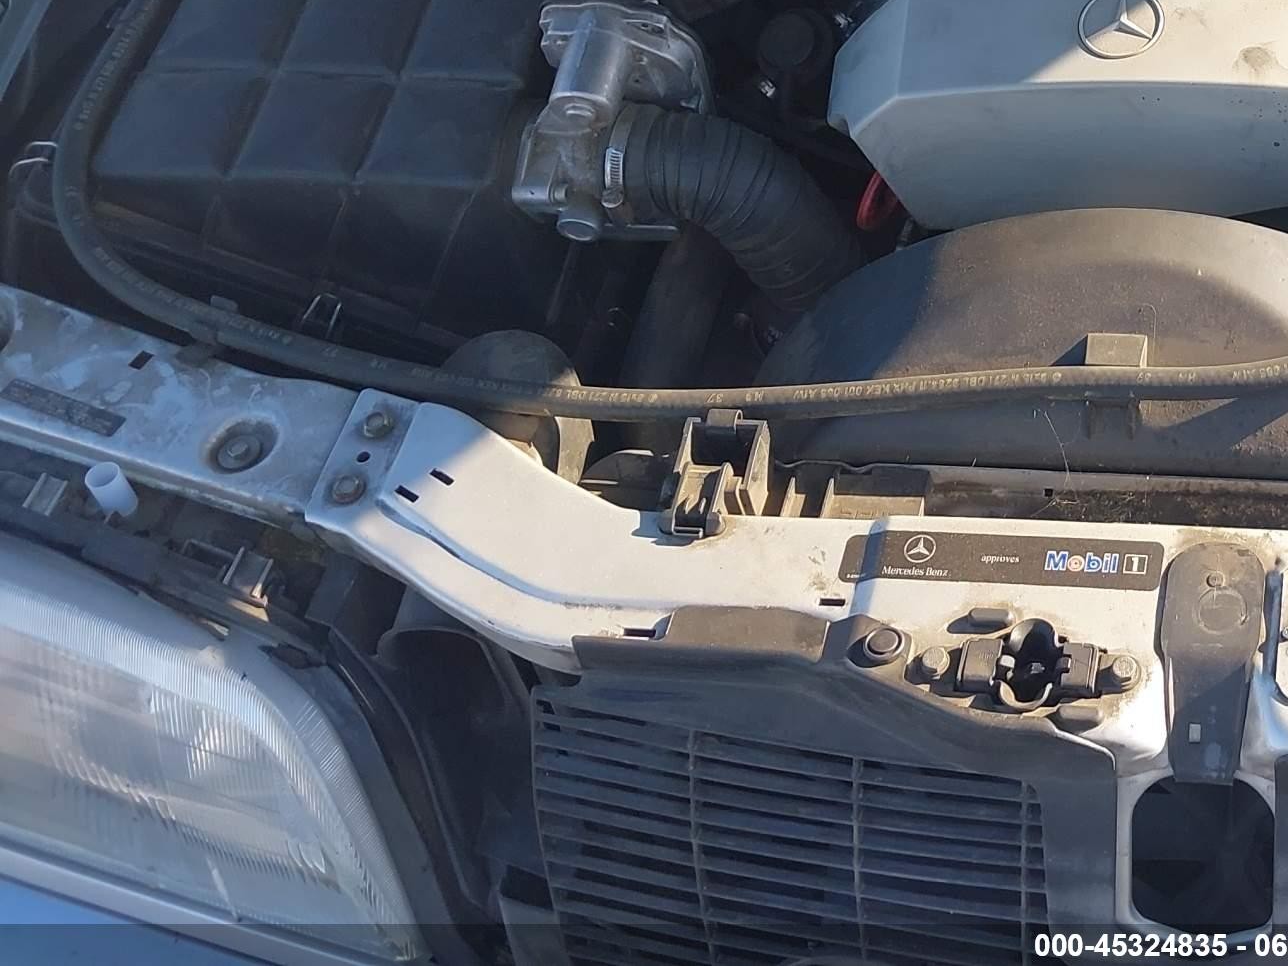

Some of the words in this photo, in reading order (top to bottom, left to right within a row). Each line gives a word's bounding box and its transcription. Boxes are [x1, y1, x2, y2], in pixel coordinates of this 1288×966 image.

[980, 553, 1020, 565] approves
[1044, 550, 1119, 574] Mobil
[881, 564, 924, 577] Mercedes
[925, 566, 948, 577] Benz
